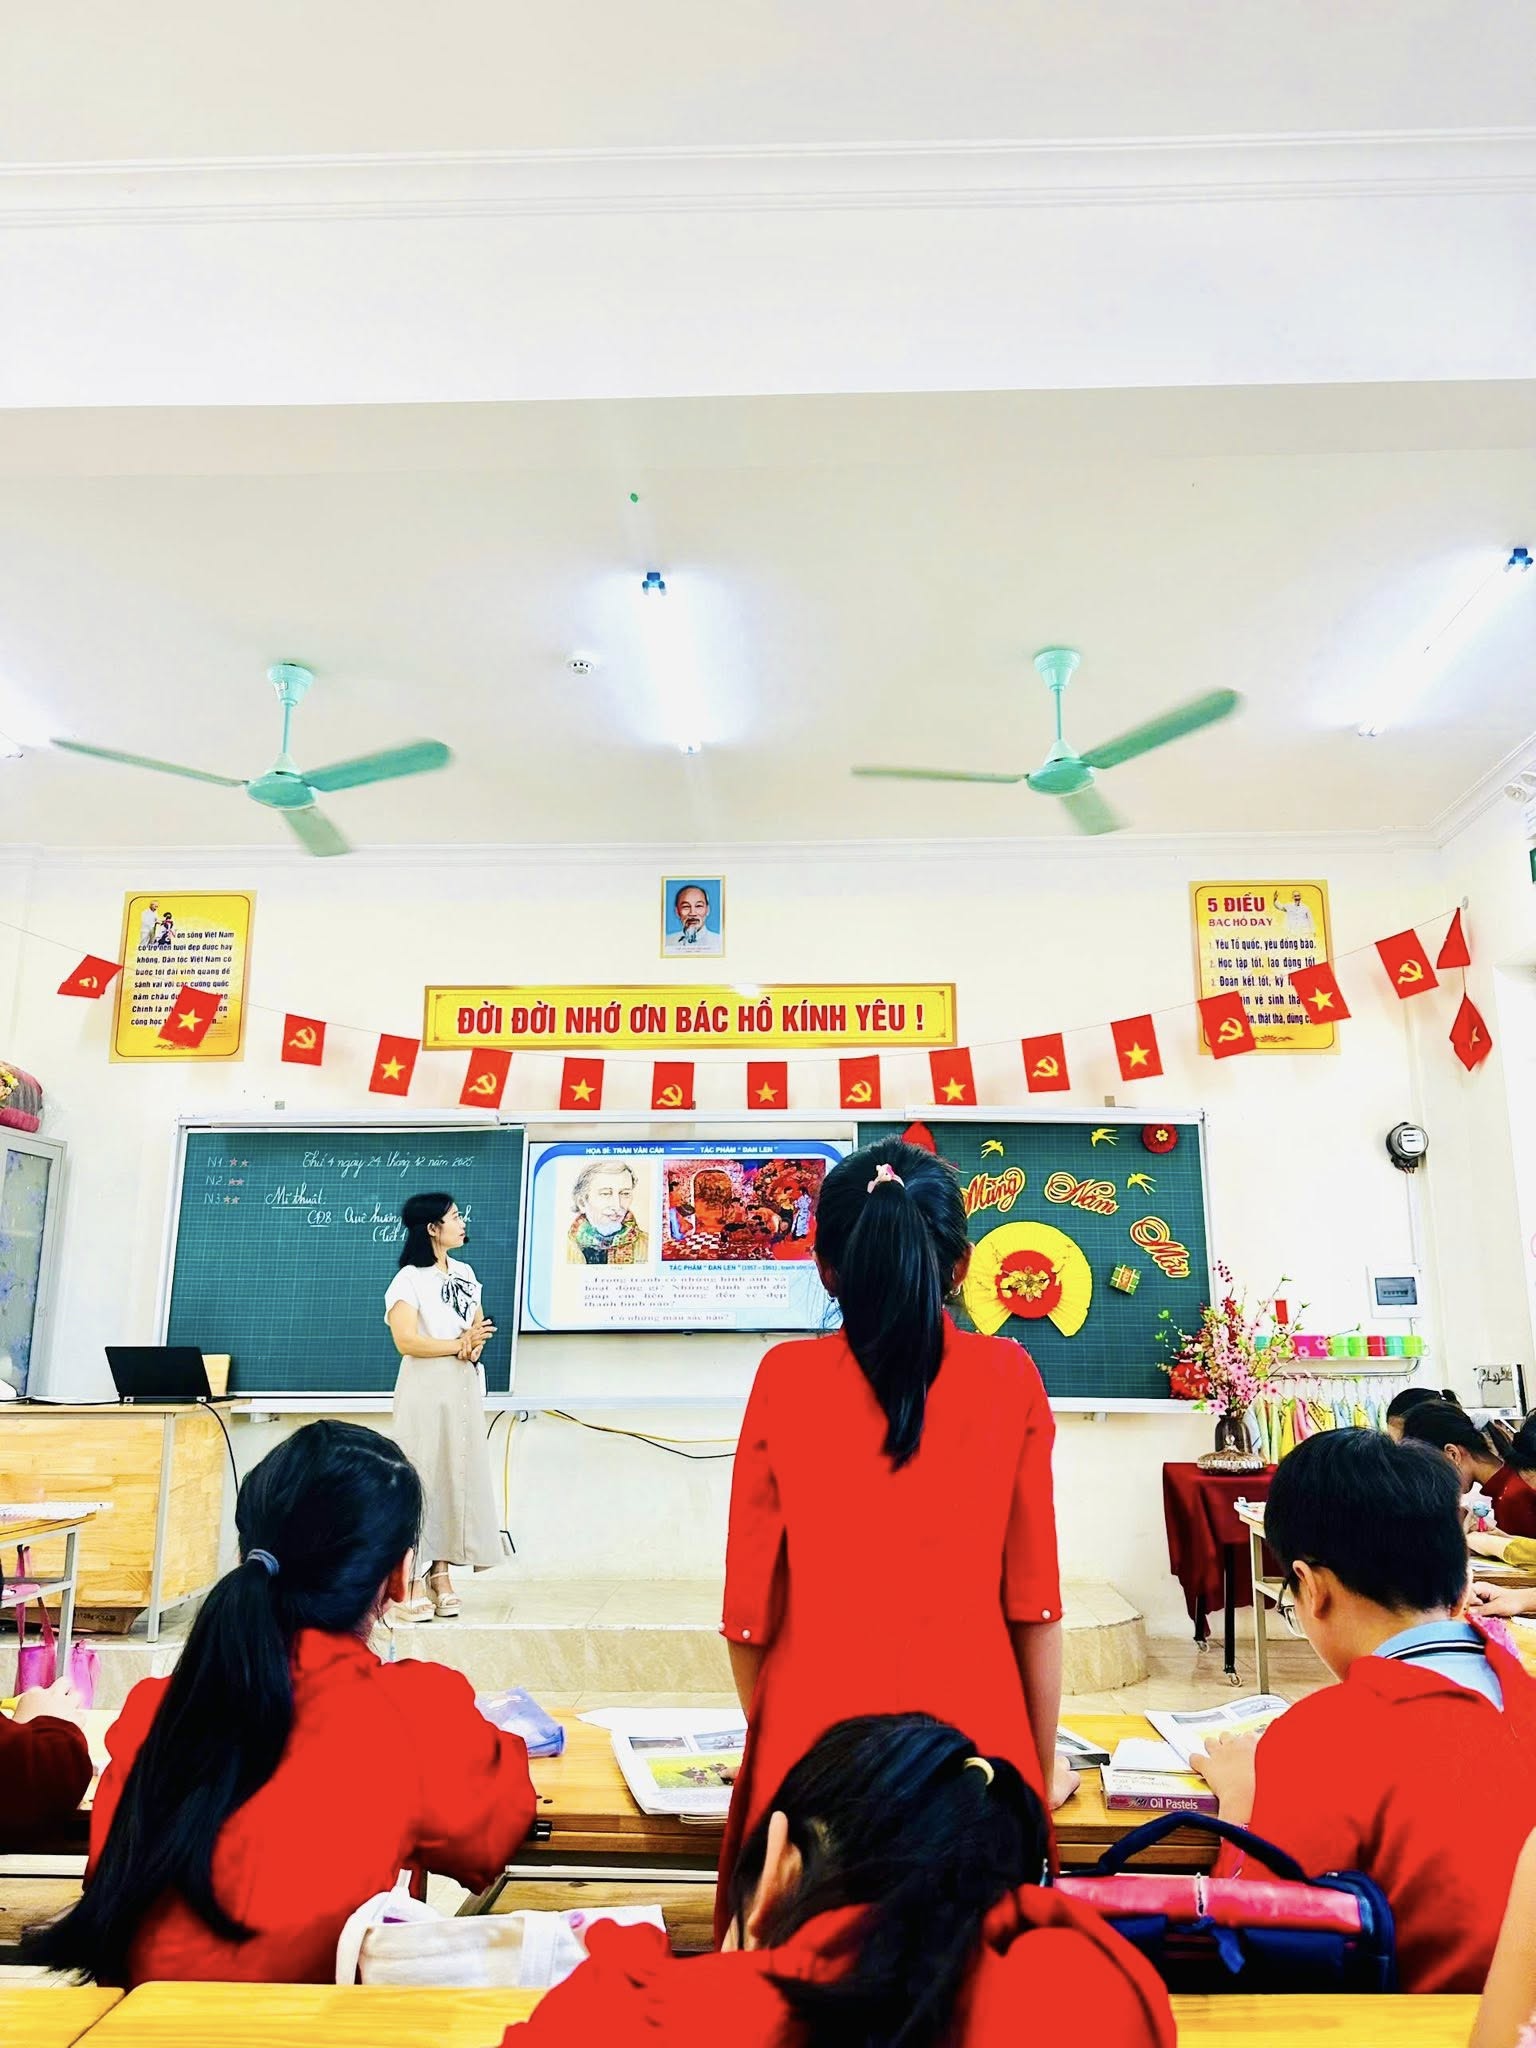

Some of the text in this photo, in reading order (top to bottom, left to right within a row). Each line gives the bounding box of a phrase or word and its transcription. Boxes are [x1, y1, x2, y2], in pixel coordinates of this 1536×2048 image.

[1207, 897, 1218, 912] 5
[204, 931, 217, 939] Việt
[219, 931, 234, 939] Nam
[220, 943, 233, 951] hay
[190, 956, 204, 964] Việt
[205, 956, 221, 964] Nam
[1218, 957, 1232, 970] Học
[1268, 957, 1280, 968] lao
[1283, 957, 1302, 969] động
[180, 968, 196, 976] vinh
[197, 968, 220, 976] quang
[152, 980, 163, 988] vai
[1268, 994, 1284, 1005] sinh
[457, 996, 923, 1034] ĐỜI ĐỜI NHỚ ƠN BÁC HỒ KÍNH YÊU !
[149, 1017, 162, 1026] học
[428, 1155, 449, 1167] năm
[1149, 1798, 1199, 1810] Oil Pastels
